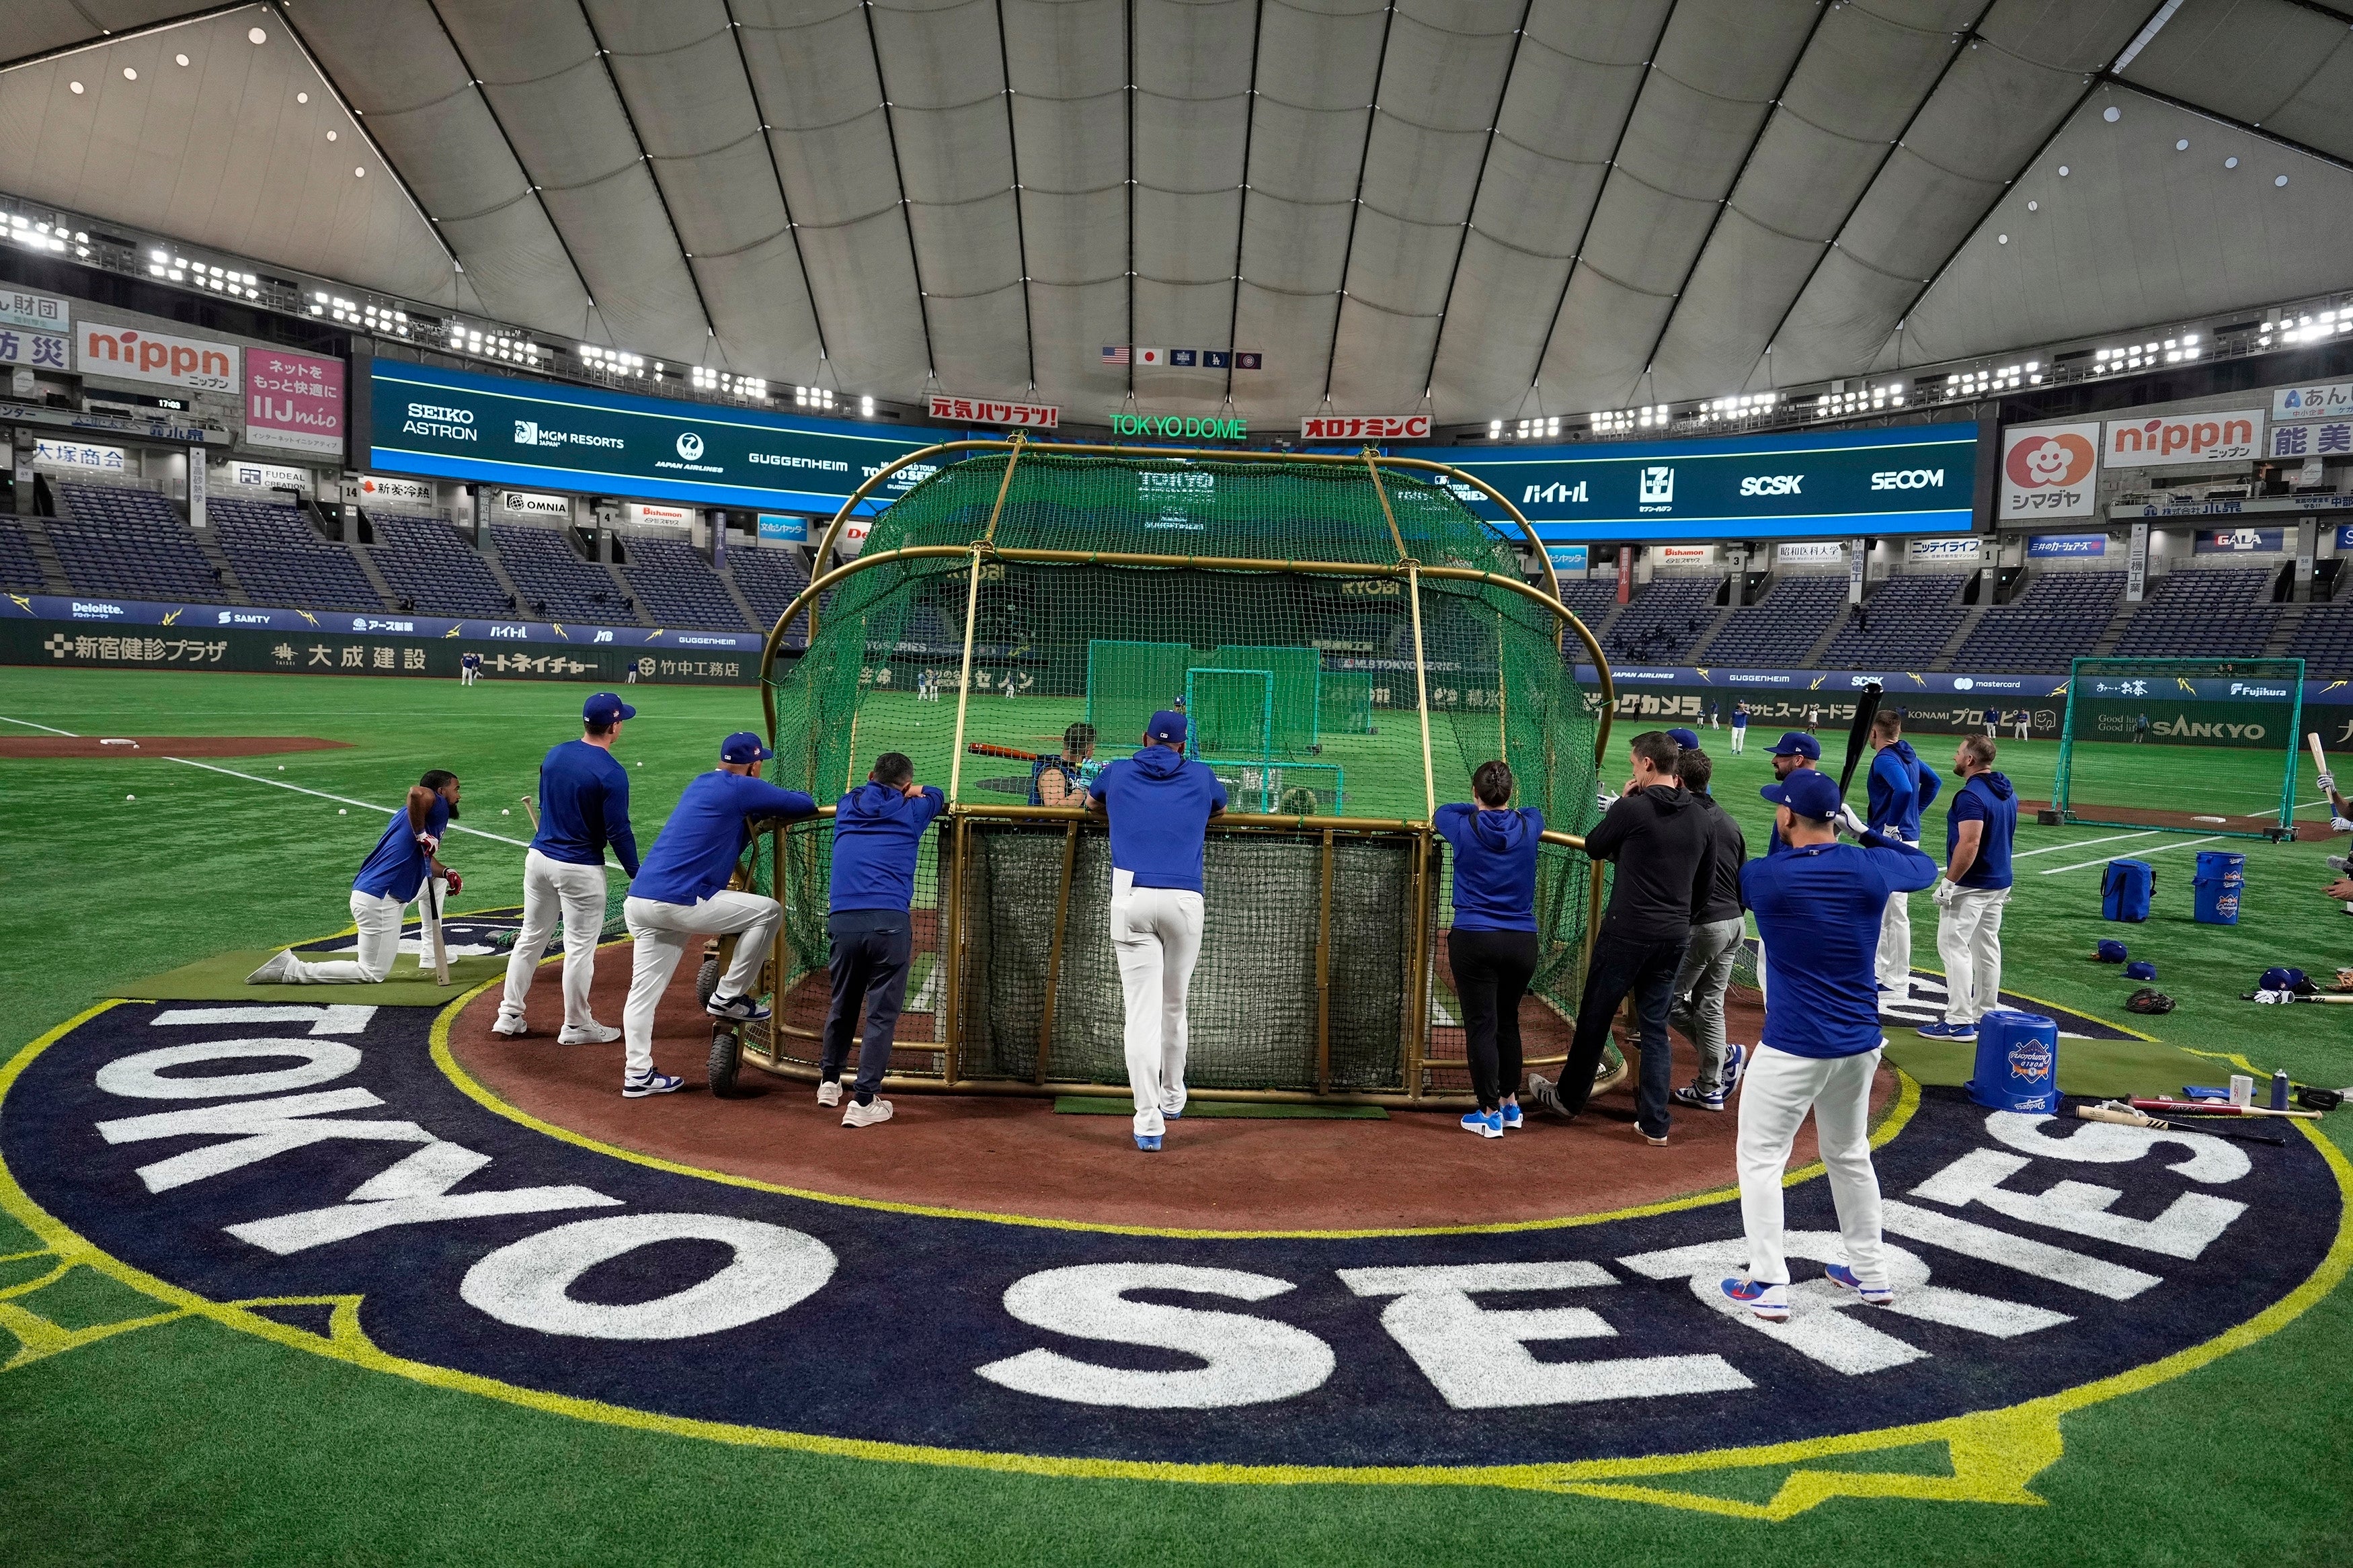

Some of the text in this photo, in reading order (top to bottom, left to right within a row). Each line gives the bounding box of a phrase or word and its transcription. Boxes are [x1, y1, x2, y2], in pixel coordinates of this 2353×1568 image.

[89, 331, 229, 377] nippn
[270, 360, 323, 380] ネットを
[189, 376, 229, 389] ニップン
[253, 374, 337, 399] もっと快適に
[2304, 387, 2353, 407] あん
[407, 403, 474, 424] SEIKO
[403, 420, 477, 442] ASTRON
[1109, 414, 1247, 439] TOKYO DOME
[1305, 417, 1427, 437] オロナミンC
[539, 429, 624, 449] MGM RESORTS
[2115, 419, 2252, 456] nippn
[2275, 424, 2351, 456] 能美
[36, 444, 123, 468] 大塚商会
[2208, 447, 2250, 458] ニップン
[655, 461, 724, 473] JAPAN AIRLINES
[748, 452, 848, 472] GUGGENHEIM
[266, 470, 305, 481] FUDEAL
[1871, 469, 1944, 490] SECOM
[264, 481, 305, 490] CREATION
[378, 483, 430, 499] 新菱冷熱
[1740, 474, 1804, 496] SCSK
[346, 487, 357, 497] 14
[1523, 481, 1589, 503] バイトル
[2012, 489, 2081, 510] シマダヤ
[527, 501, 566, 512] OMNIA
[643, 507, 682, 518] Bishamon
[2162, 501, 2242, 515] 株式会社 小泉
[604, 513, 610, 522] 4
[760, 522, 807, 534] 文化シャッター
[2217, 534, 2262, 546] GALA
[1665, 548, 1704, 556] Bishamon
[1780, 546, 1839, 556] 昭和医科大学
[1912, 541, 1979, 553] ニッテイライフ
[1734, 557, 1739, 565] 3
[1985, 550, 1991, 560] 1
[2130, 550, 2143, 593] 三機工業
[234, 614, 270, 624] SAMTY
[369, 620, 413, 632] アース製薬
[490, 626, 528, 638] バイトル
[594, 630, 613, 643] JTB
[679, 636, 736, 645] GUGGENHEIM
[75, 636, 227, 662] 新宿健診プラザ
[309, 644, 426, 669] 大成建設
[661, 659, 740, 677] 竹中工務店
[1729, 674, 1790, 682] GUGGENHEIM
[1851, 675, 1883, 686] SCSK
[1976, 680, 2020, 688] mastercard
[2242, 687, 2286, 697] Fujikura
[1908, 710, 1949, 720] KONAMI
[2098, 714, 2138, 723] Good luc
[2098, 723, 2137, 731] Good lif
[2152, 713, 2266, 740] SANKYO
[95, 1005, 2253, 1410] TOKYO SERIES
